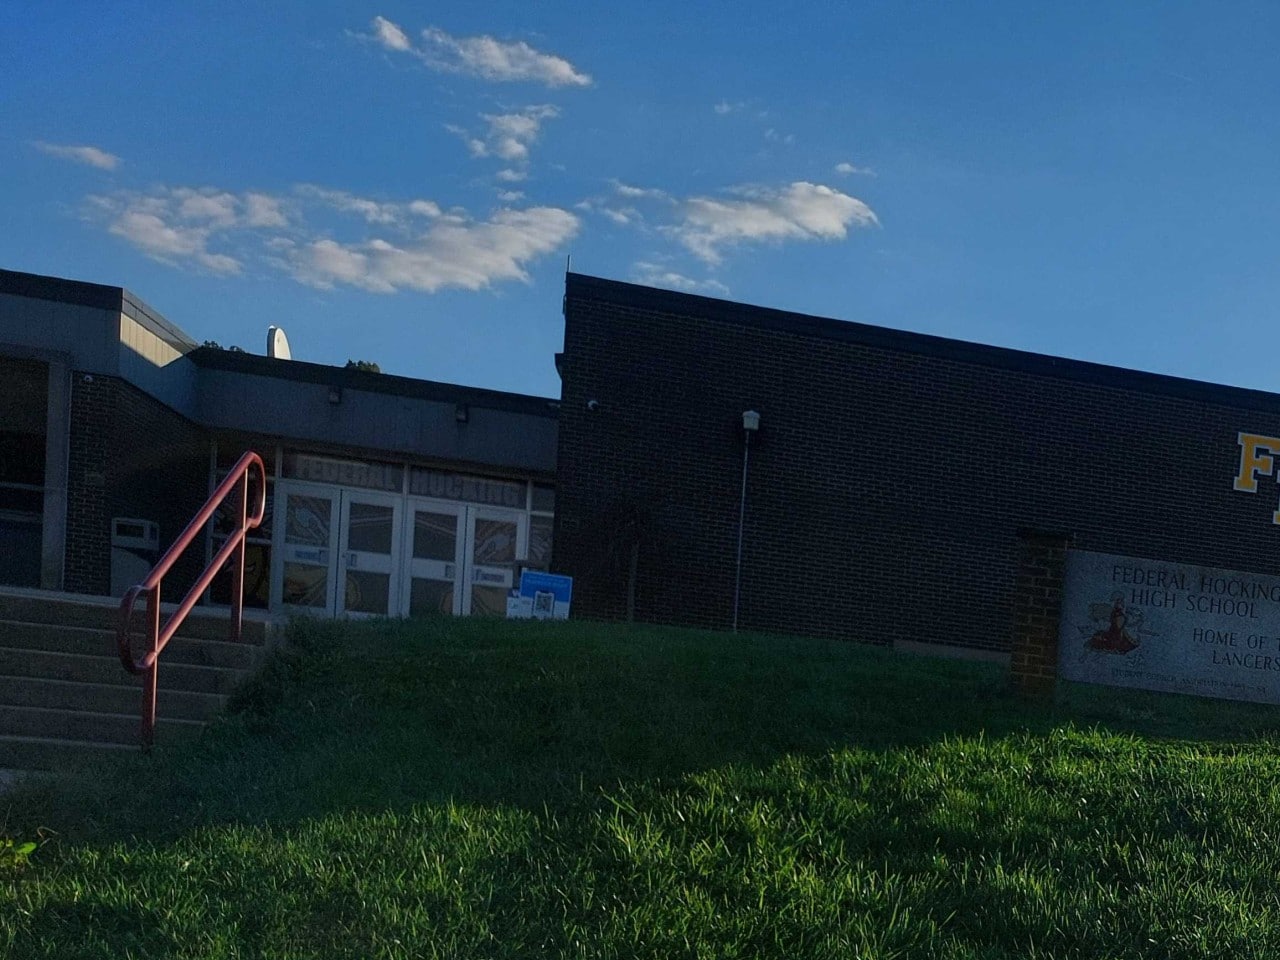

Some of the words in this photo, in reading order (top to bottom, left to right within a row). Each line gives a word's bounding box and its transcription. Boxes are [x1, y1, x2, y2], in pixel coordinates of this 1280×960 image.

[1112, 564, 1190, 591] FEDERAL
[1130, 588, 1176, 609] HIGH
[1186, 594, 1259, 619] SCHOOL
[1193, 627, 1238, 647] HOME
[1247, 634, 1267, 650] OF
